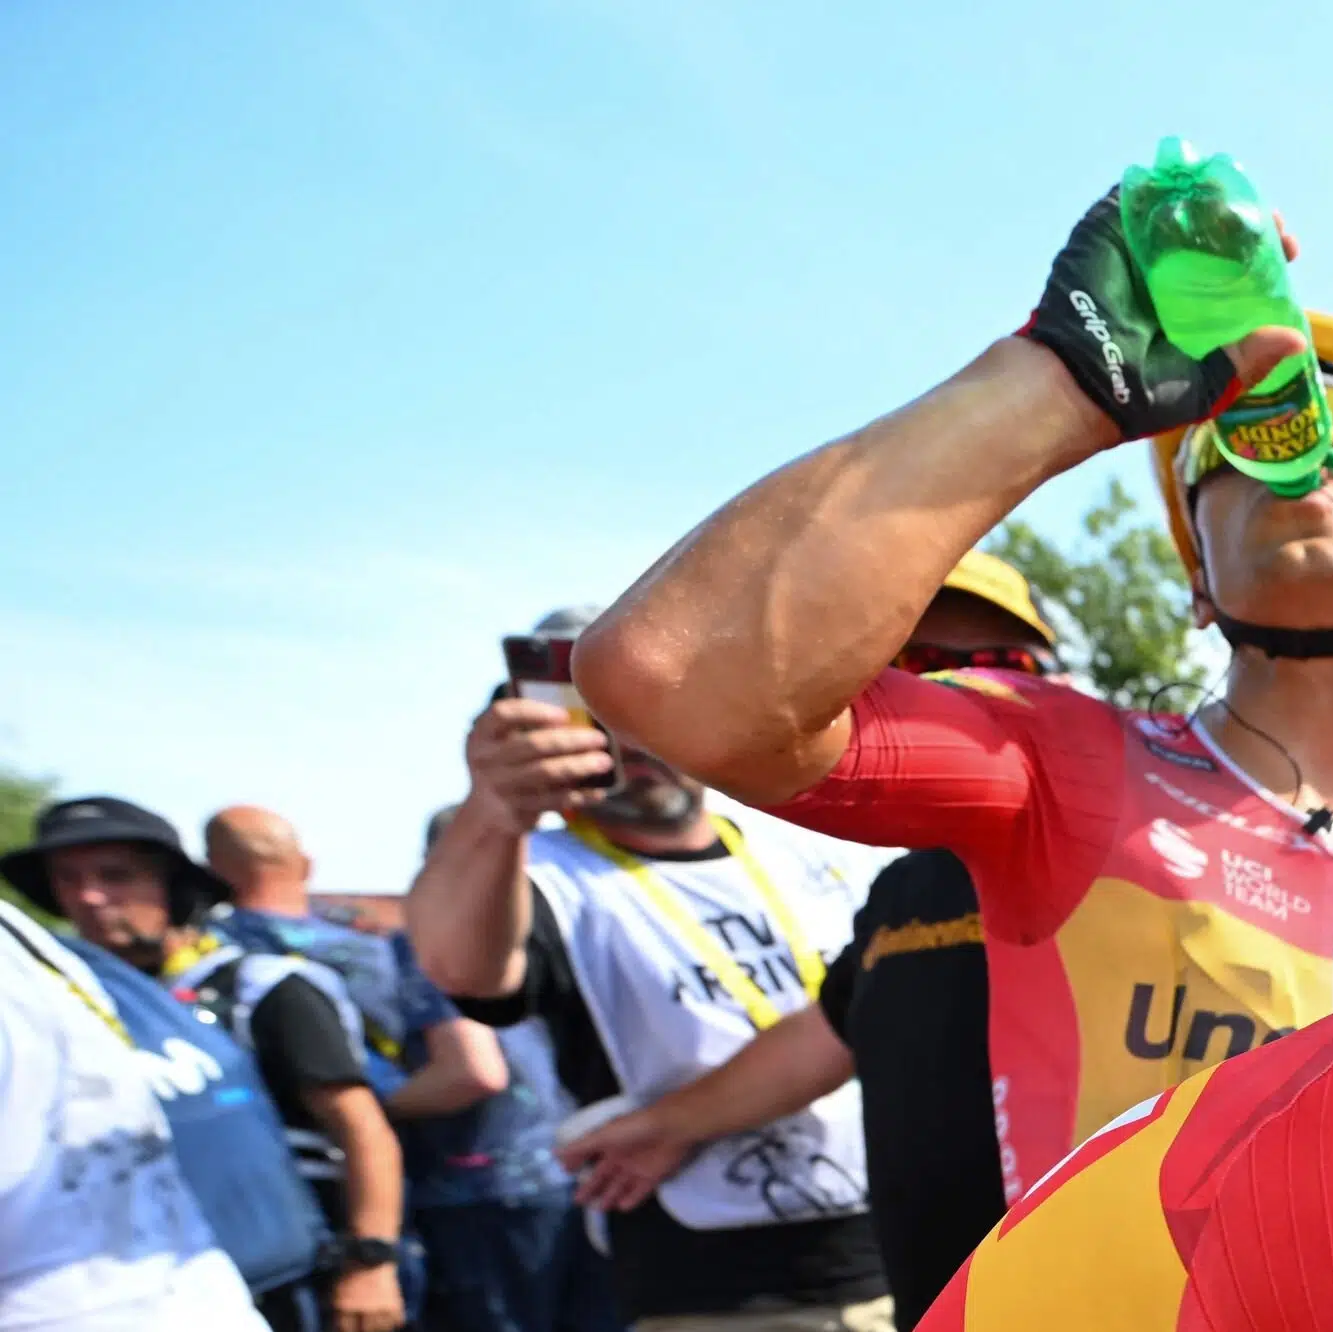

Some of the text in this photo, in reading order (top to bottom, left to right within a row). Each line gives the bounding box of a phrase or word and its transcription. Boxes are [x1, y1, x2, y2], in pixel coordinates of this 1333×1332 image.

[1069, 289, 1131, 404] GripGrab
[1221, 850, 1273, 882] UCI
[1222, 866, 1311, 914] WORLD
[1224, 881, 1288, 921] TEAM
[703, 911, 775, 952] TV
[1124, 983, 1300, 1062] Un
